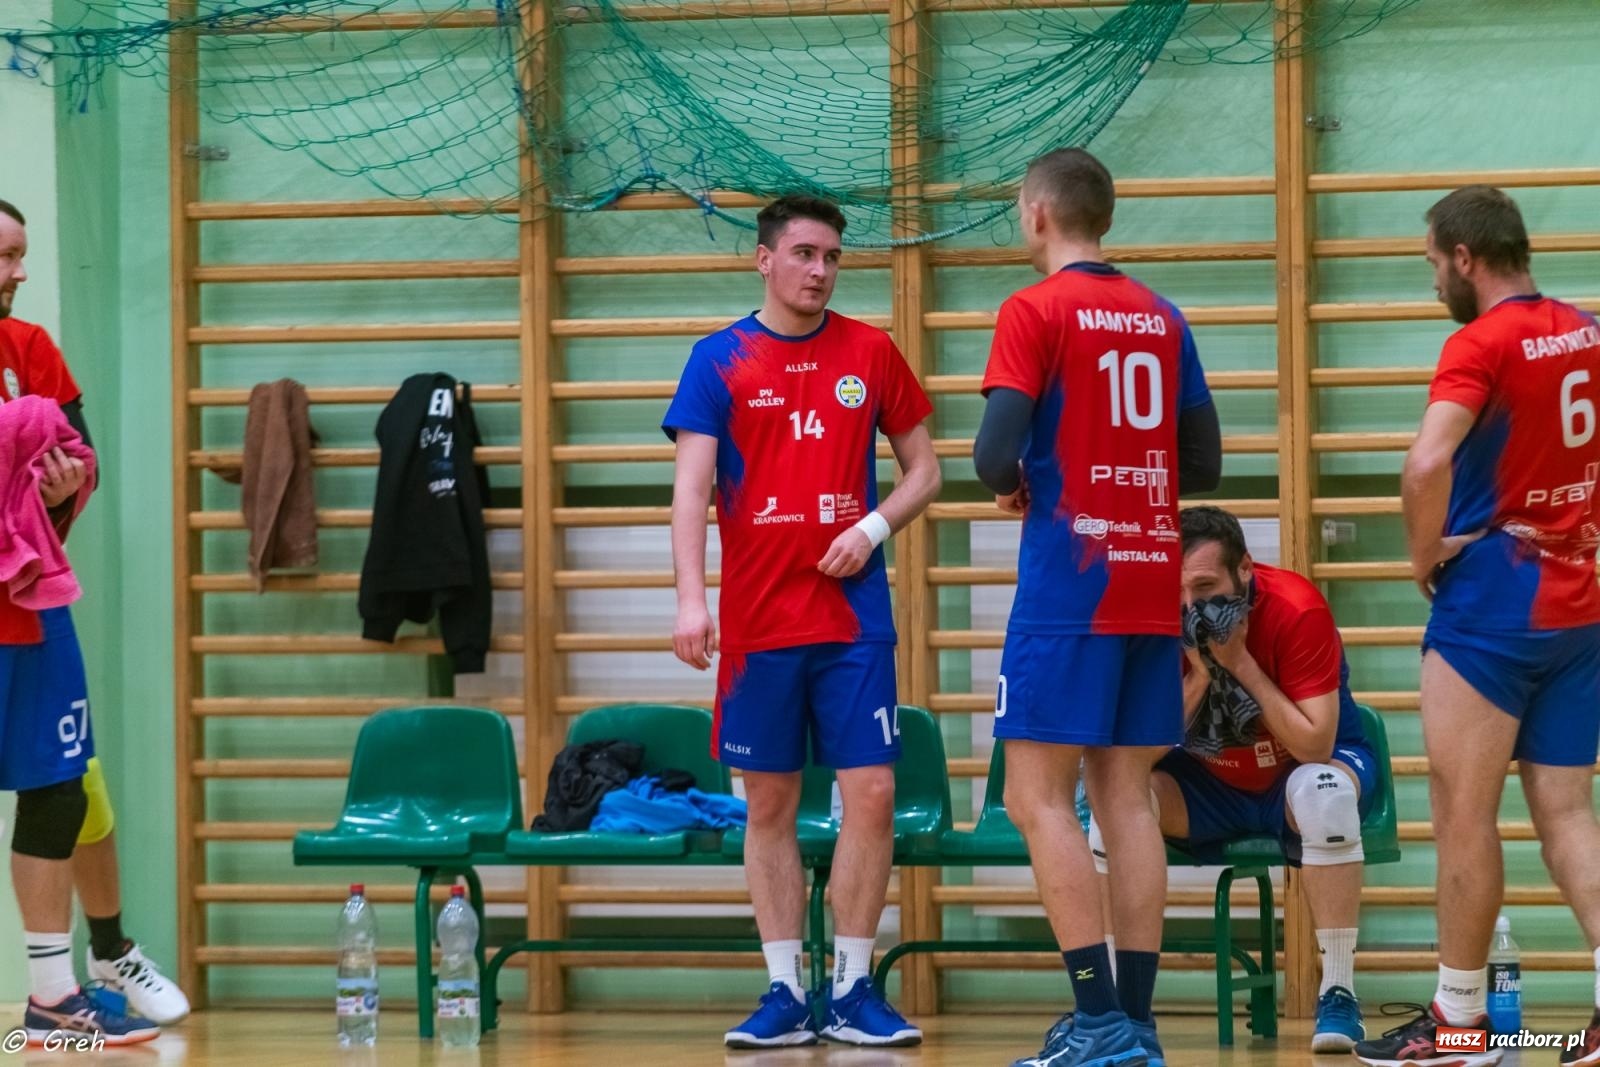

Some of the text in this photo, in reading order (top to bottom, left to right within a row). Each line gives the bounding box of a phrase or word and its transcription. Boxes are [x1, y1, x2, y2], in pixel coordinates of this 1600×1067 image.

[1076, 309, 1166, 336] NAMYSŁO
[759, 388, 773, 398] PV
[1098, 349, 1164, 431] 10
[748, 397, 785, 408] VOLLEY
[1560, 369, 1596, 449] 6
[789, 409, 825, 440] 14
[753, 513, 805, 525] KRAPKOWICE
[1108, 520, 1142, 533] Technik
[58, 699, 88, 759] 97
[724, 742, 751, 755] ALLSIX
[1441, 984, 1481, 996] SPORT
